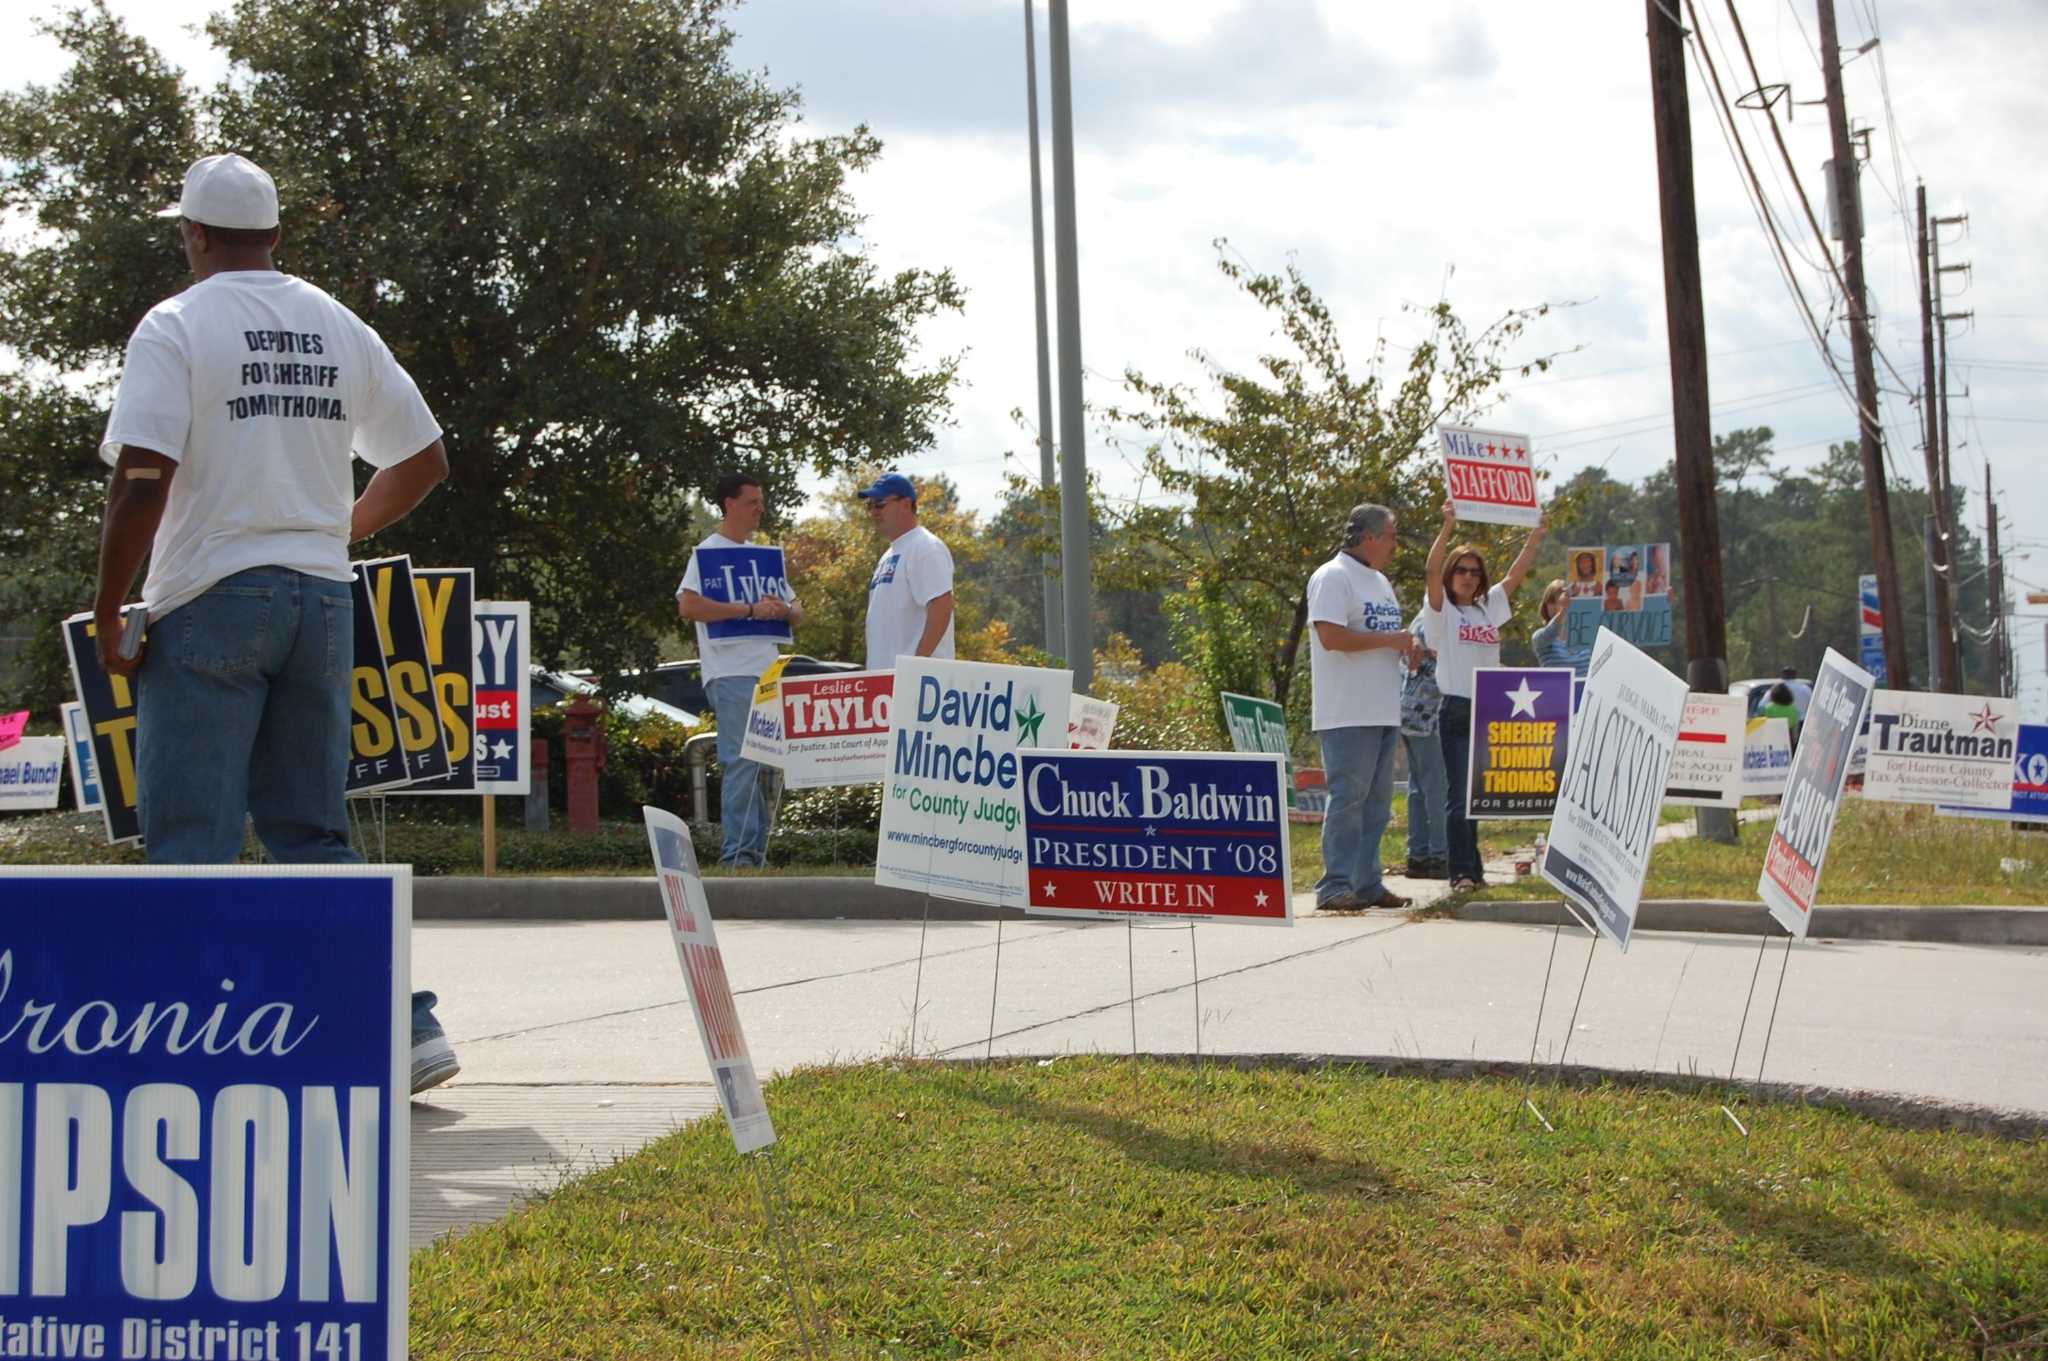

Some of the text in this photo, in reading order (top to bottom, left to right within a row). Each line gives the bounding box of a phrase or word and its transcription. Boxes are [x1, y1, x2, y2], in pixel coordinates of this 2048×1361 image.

[243, 330, 324, 355] DEPUTIES
[241, 362, 339, 388] FOR SHERIFF
[281, 395, 347, 421] THOMA
[1445, 433, 1486, 458] Mike
[1448, 462, 1532, 502] STAFFORD
[704, 577, 723, 590] PAT
[812, 680, 868, 696] Leslie C.
[917, 674, 1013, 732] David
[1487, 720, 1558, 745] SHERIFF
[1874, 713, 2013, 759] Trautman
[1901, 713, 1950, 730] Diane
[893, 728, 1018, 790] Mincbe
[1488, 746, 1554, 769] TOMMY
[1482, 769, 1558, 794] THOMAS
[1561, 689, 1672, 858] JACKSON
[1027, 762, 1276, 823] Chuck Baldwin
[1471, 798, 1501, 809] FOR
[892, 783, 1021, 832] for County Judg
[1032, 836, 1217, 872] PRESIDENT
[1094, 879, 1217, 908] WRITE IN
[0, 948, 320, 1056] ronia
[0, 1082, 381, 1304] PSON
[122, 1317, 281, 1361] District
[293, 1321, 362, 1361] 141
